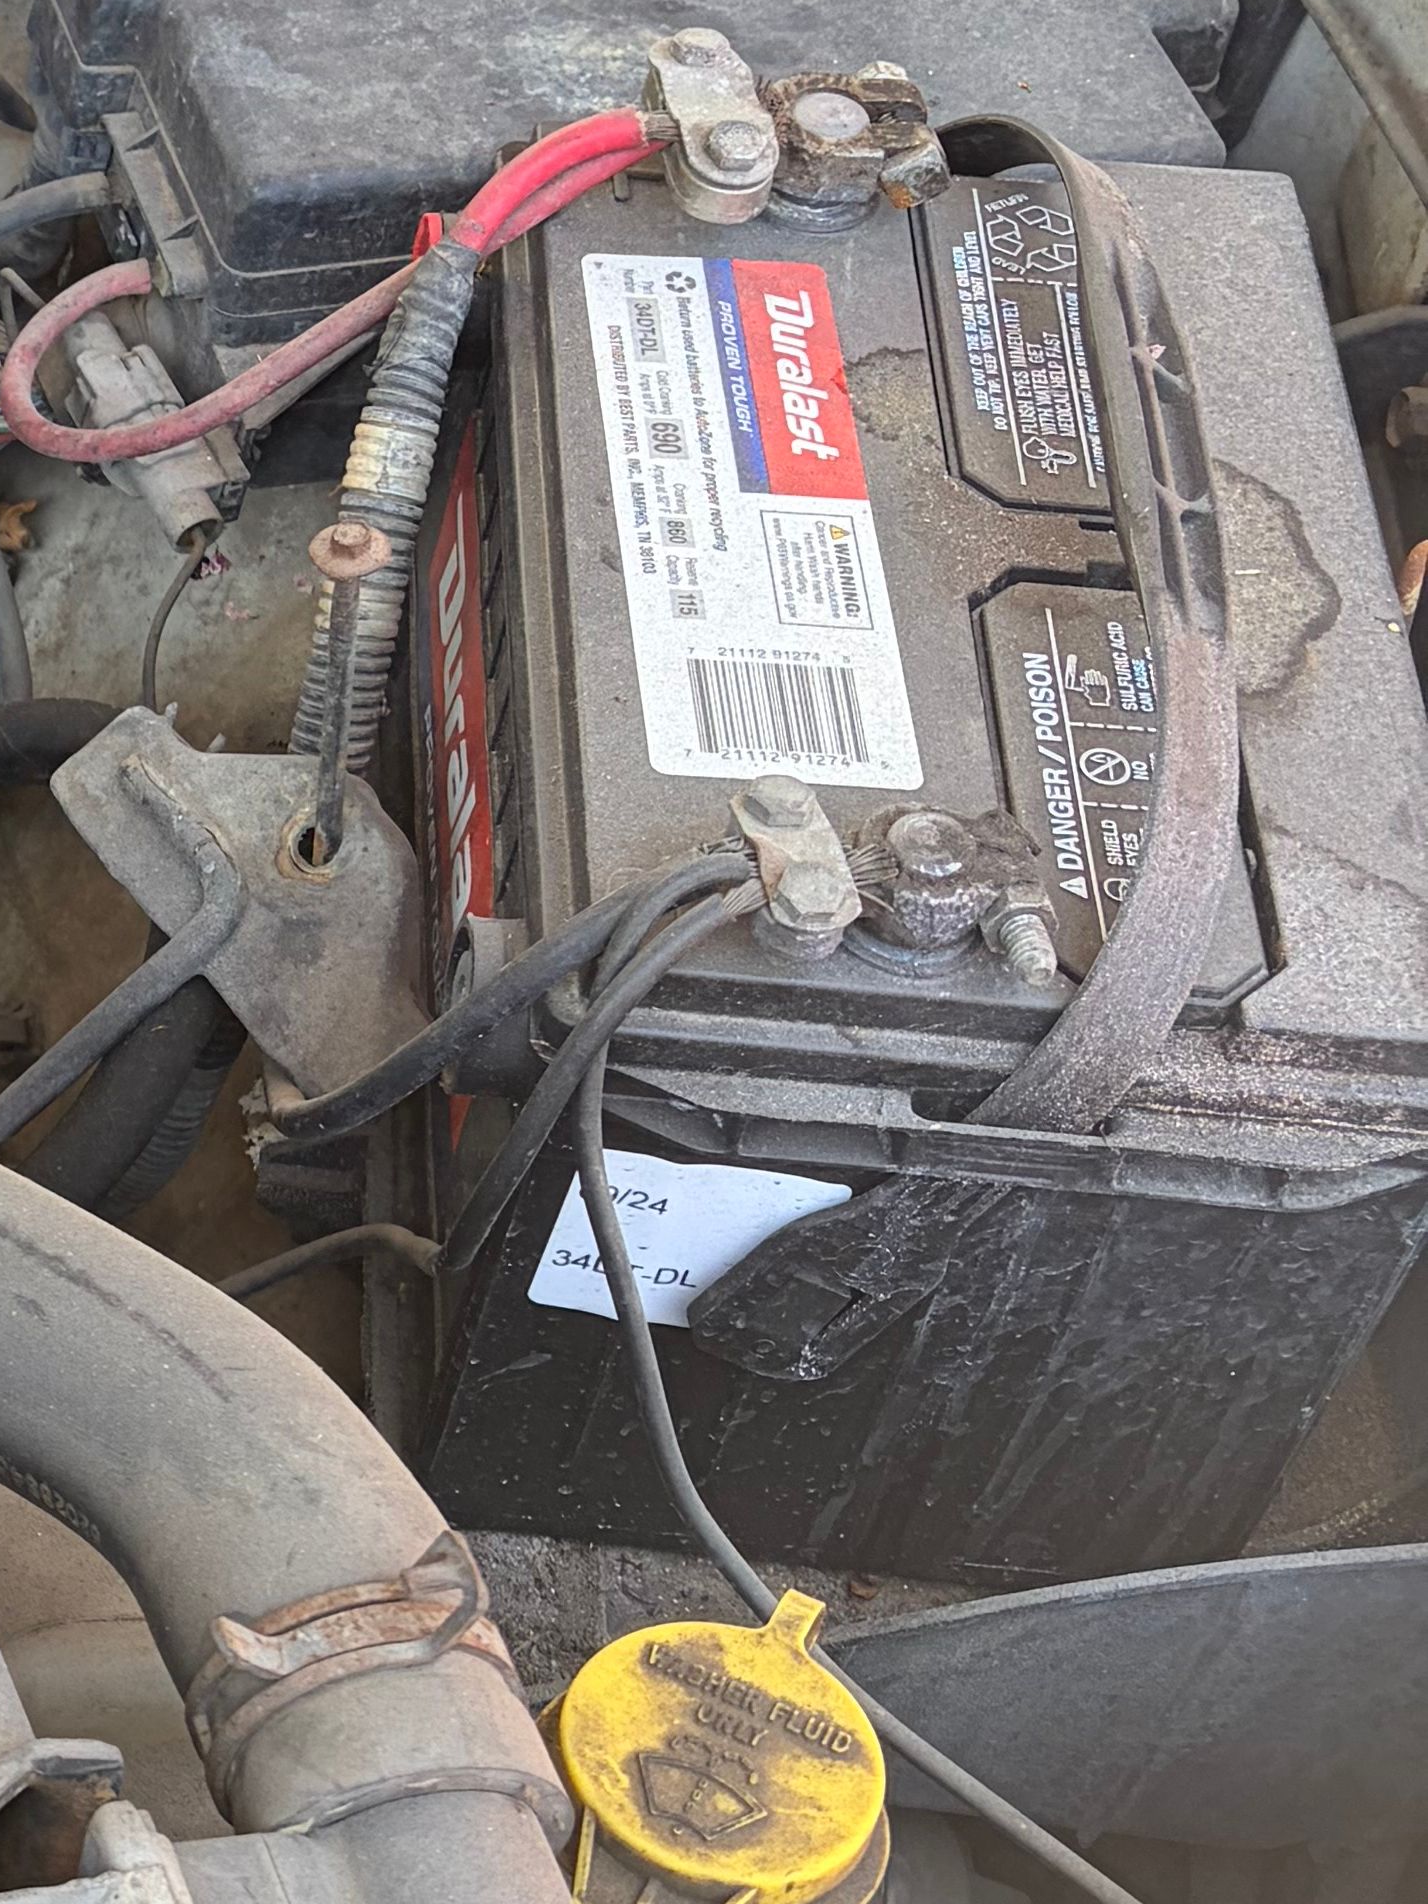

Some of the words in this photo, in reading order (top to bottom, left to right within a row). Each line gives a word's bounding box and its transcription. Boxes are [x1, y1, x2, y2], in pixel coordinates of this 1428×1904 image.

[633, 302, 658, 355] 34DT-DL
[1001, 298, 1027, 367] IMMEDIATELY
[1042, 330, 1063, 359] FAST
[718, 300, 742, 371] PROVEN
[732, 375, 753, 433] TOUGH
[1025, 341, 1045, 363] GET
[764, 291, 840, 461] Duralast
[1011, 370, 1031, 397] EYES
[1030, 367, 1052, 405] WATER
[1047, 360, 1068, 389] HELP
[1016, 399, 1035, 434] FLUSH
[1036, 407, 1058, 435] WITH
[1051, 389, 1076, 437] MEDICAL
[651, 422, 683, 454] 690
[666, 520, 686, 544] 860
[677, 592, 698, 616] 115
[1107, 621, 1129, 657] ACID
[1023, 653, 1063, 742] POISON
[1115, 661, 1138, 711] SULFURIC
[721, 750, 779, 763] 21112
[791, 753, 851, 768] 91274
[1132, 762, 1149, 780] NO
[1042, 768, 1083, 871] DANGER
[1103, 819, 1123, 865] SHIELD
[768, 1702, 853, 1754] FLUID
